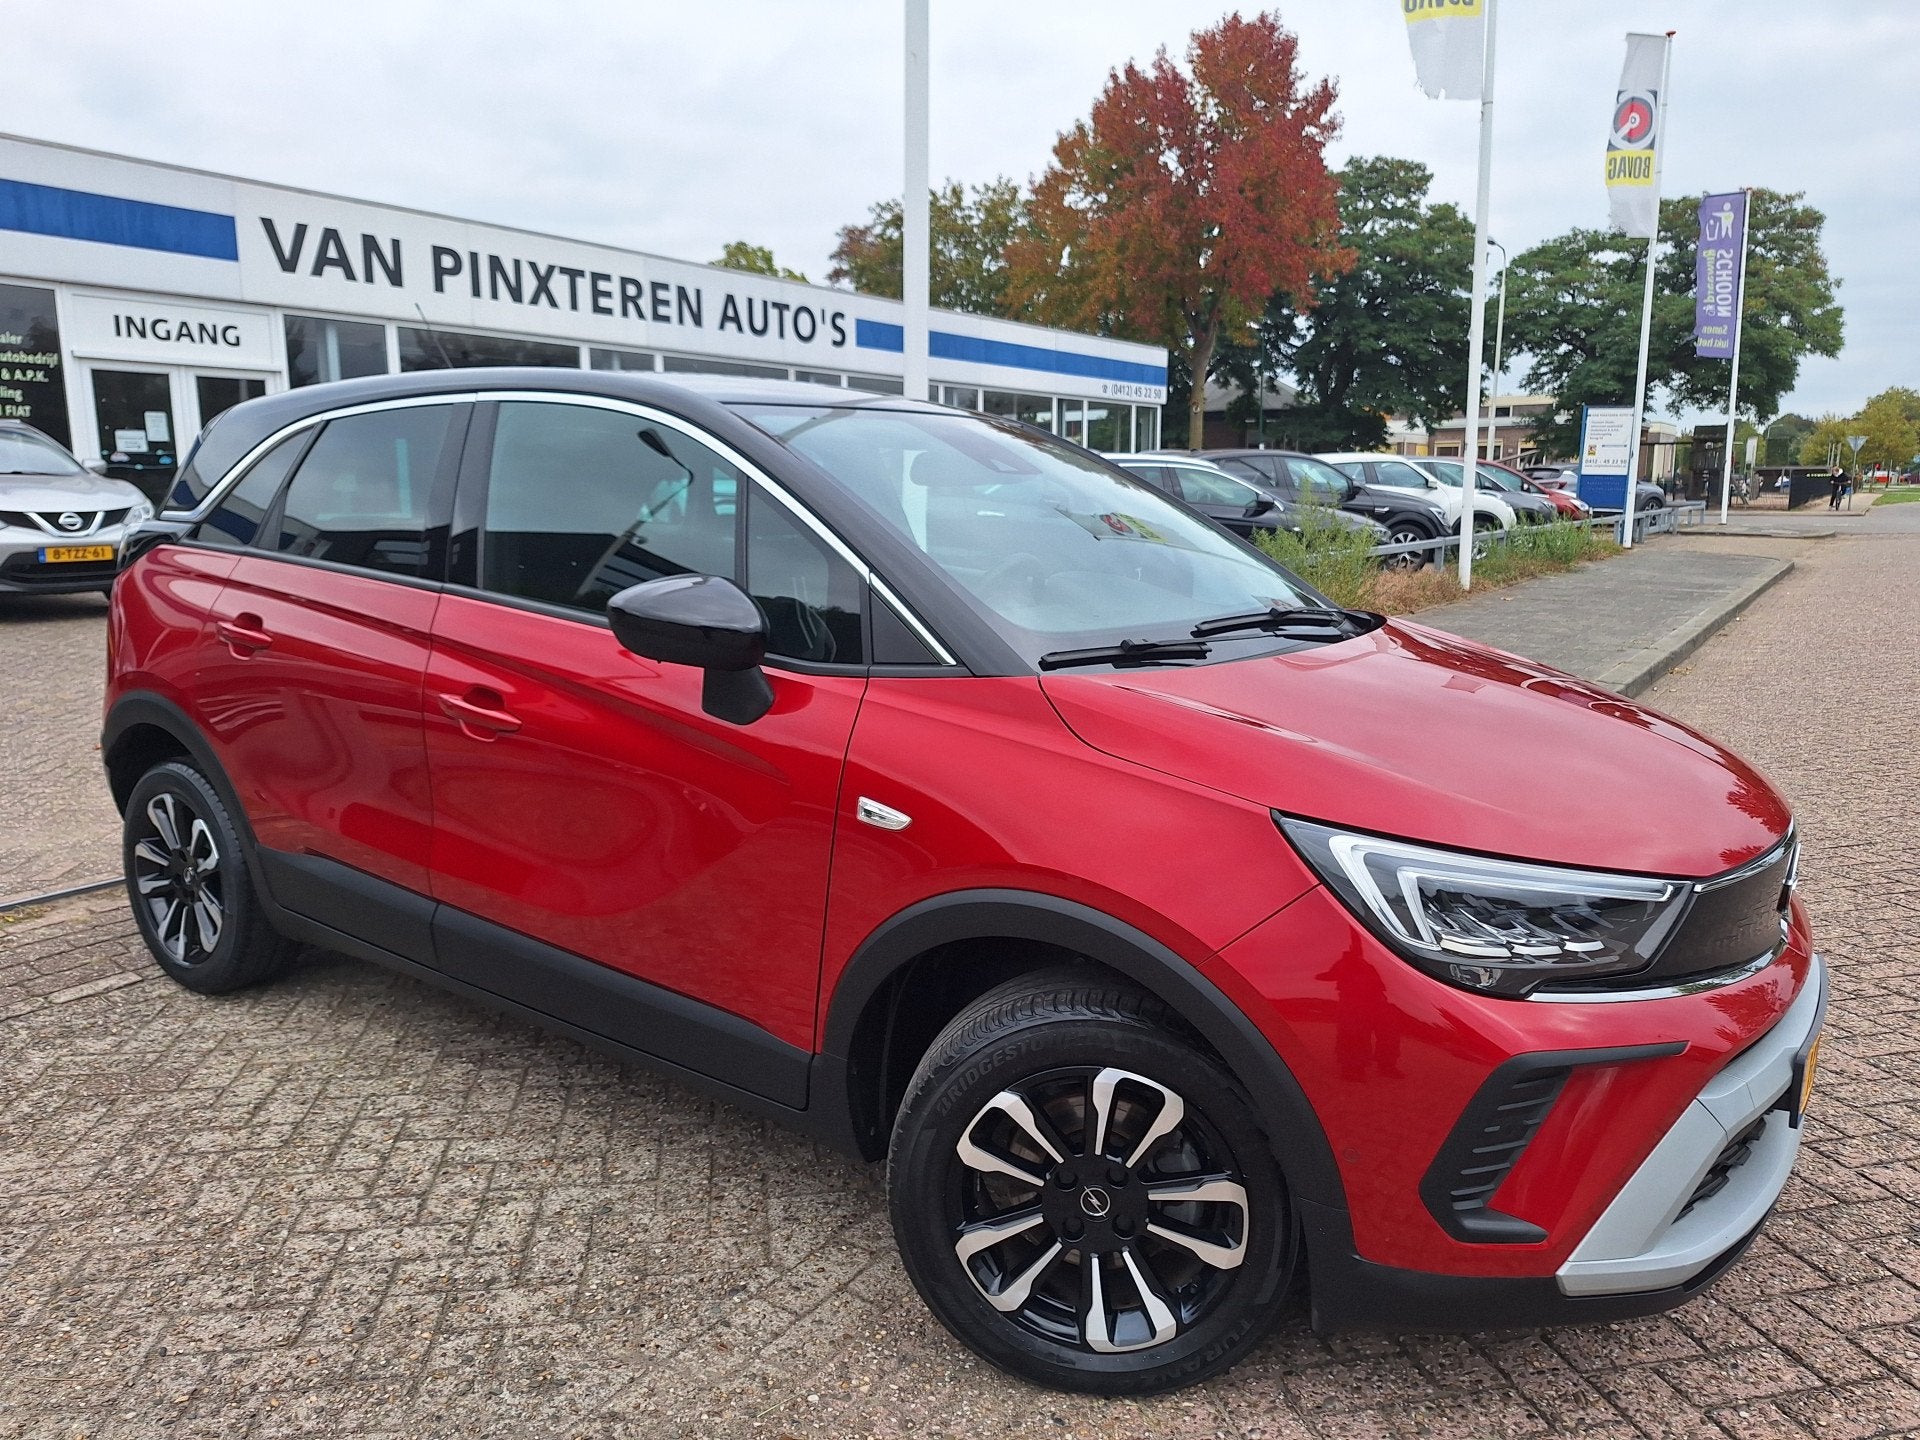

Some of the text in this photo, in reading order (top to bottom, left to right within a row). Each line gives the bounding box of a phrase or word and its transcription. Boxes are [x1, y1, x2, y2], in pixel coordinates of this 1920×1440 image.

[260, 217, 848, 347] VAN PINXTEREN AUTO'S
[114, 314, 242, 347] INGANG
[0, 367, 49, 383] & A.P.K.
[1110, 383, 1133, 398] (0412)
[1134, 385, 1142, 398] 45
[1144, 388, 1152, 399] 22
[5, 405, 33, 418] FIAT
[53, 547, 107, 561] 8-TZZ-61
